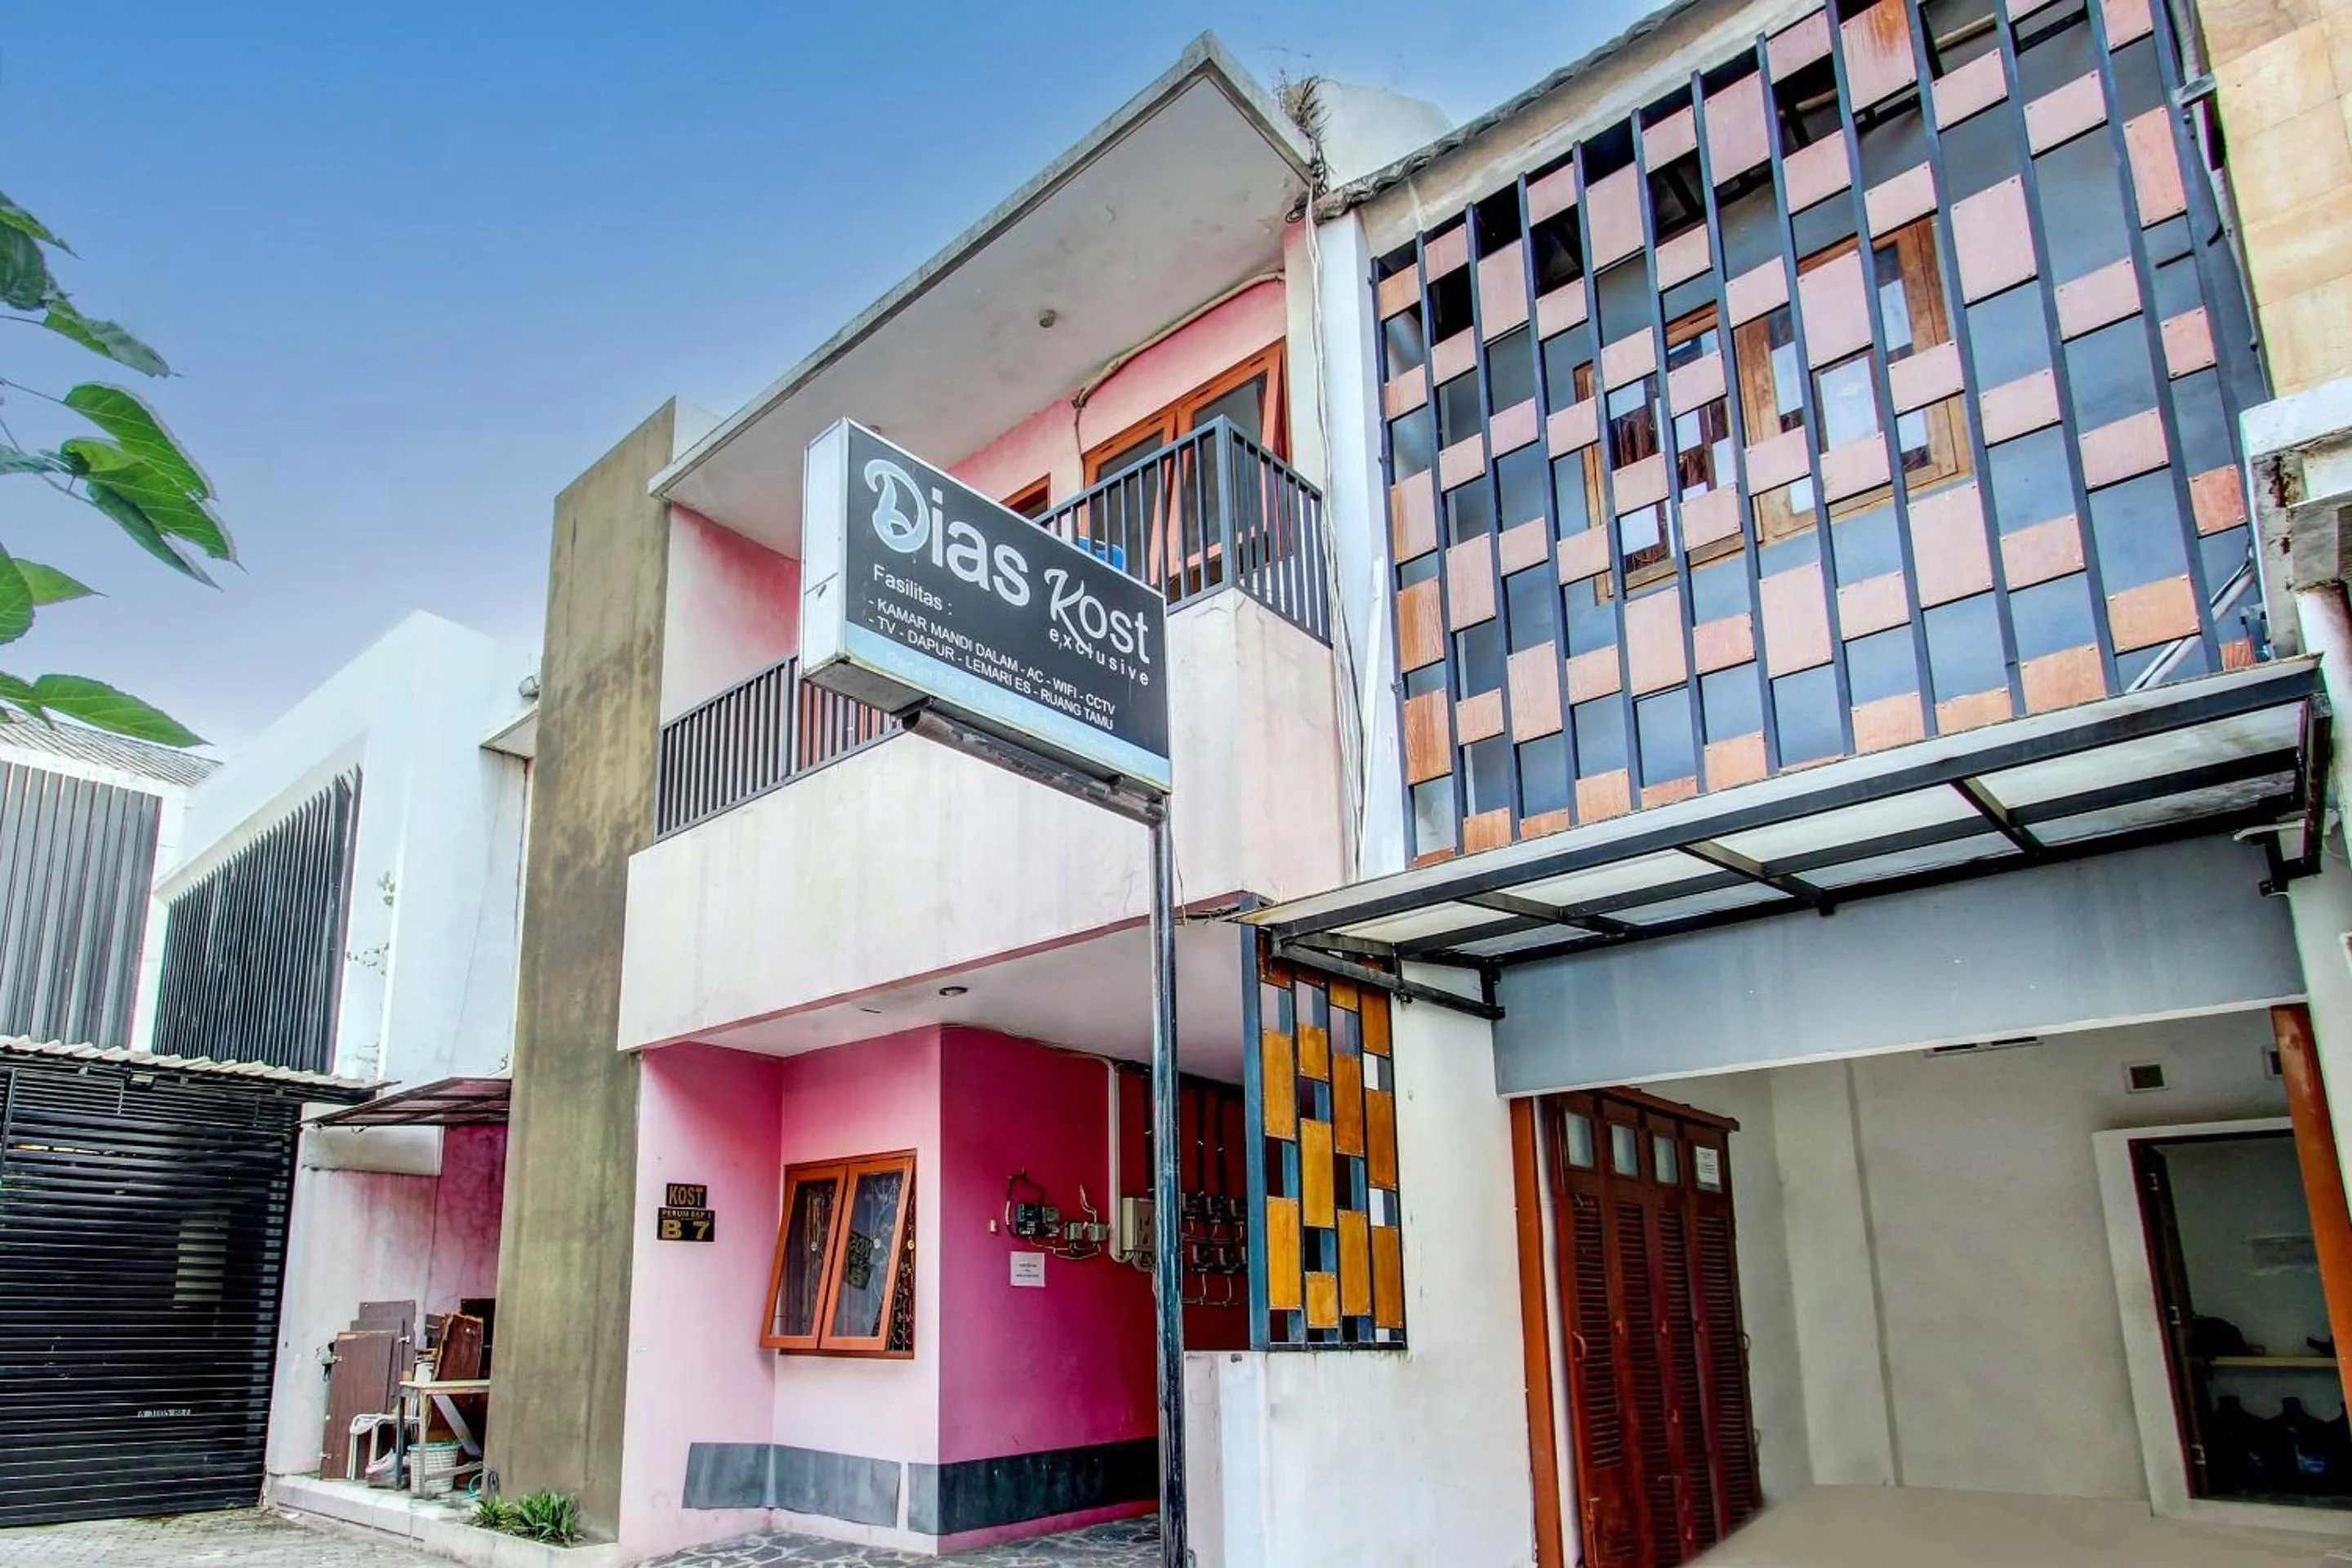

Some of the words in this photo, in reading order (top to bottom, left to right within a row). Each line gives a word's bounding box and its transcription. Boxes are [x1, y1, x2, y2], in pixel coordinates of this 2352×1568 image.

[864, 459, 1031, 606] Dias
[1044, 568, 1150, 664] Kost
[873, 563, 943, 611] Fasilitas
[876, 615, 896, 635] TV
[907, 629, 955, 662] DAPUR
[965, 654, 1013, 687] LEMARI
[1015, 676, 1031, 694] ES
[1040, 687, 1082, 716] RUANG
[1083, 706, 1114, 731] TAMU
[877, 597, 928, 632] KAMAR
[931, 621, 973, 653] MANDI
[976, 642, 1018, 672] DALAM
[1027, 666, 1044, 684] AC
[1053, 676, 1077, 699] WIFI
[1085, 693, 1116, 715] CCTV
[1049, 628, 1149, 685] exclusive
[669, 1185, 704, 1206] KOST
